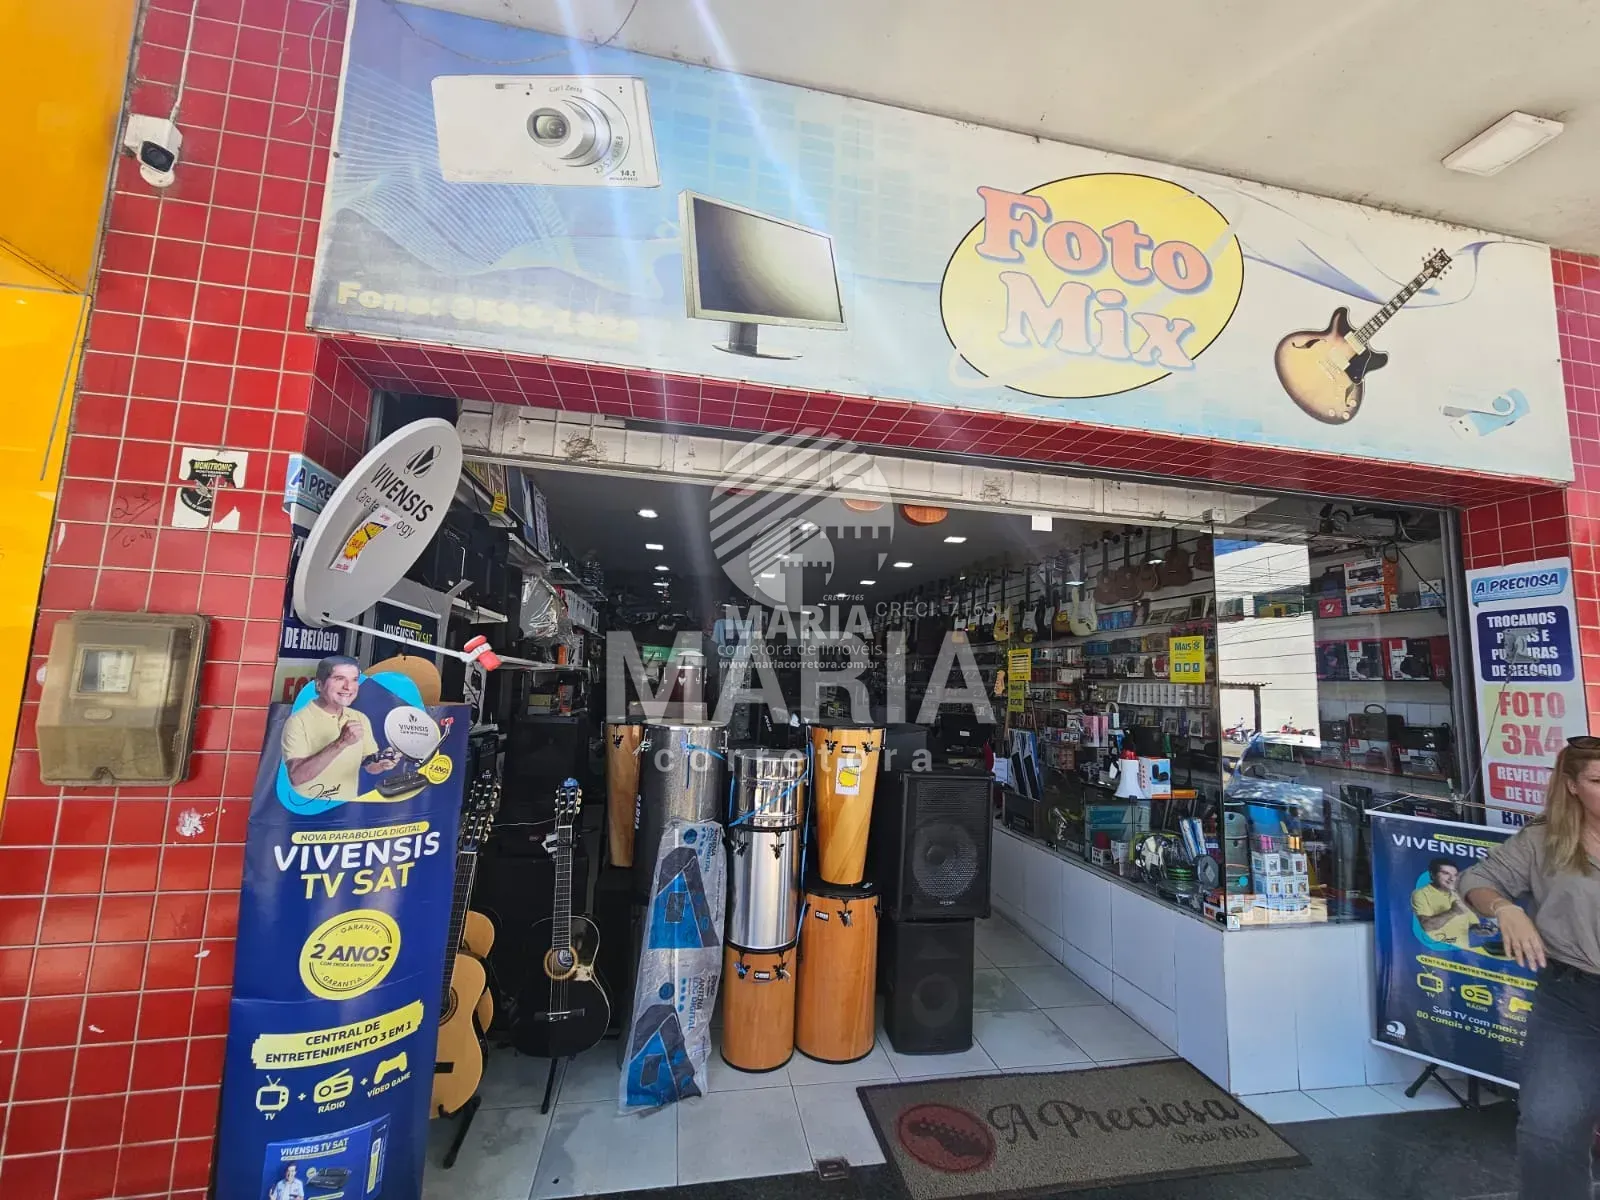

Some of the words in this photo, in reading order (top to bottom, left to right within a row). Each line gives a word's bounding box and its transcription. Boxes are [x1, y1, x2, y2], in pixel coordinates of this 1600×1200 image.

[975, 186, 1213, 294] Foto
[999, 270, 1196, 370] Mix
[290, 466, 306, 489] A
[371, 462, 436, 522] VIVENSIS
[1475, 582, 1486, 594] A
[1489, 573, 1559, 592] PRECIOSA
[1486, 611, 1557, 628] TROCAMOS
[284, 626, 298, 649] DE
[1541, 629, 1551, 642] E
[1491, 664, 1507, 677] DE
[1498, 691, 1566, 719] FOTO
[1501, 723, 1565, 757] 3X4
[1504, 786, 1523, 800] DE
[300, 833, 328, 842] NOVA
[389, 824, 422, 837] DIGITAL
[1392, 833, 1489, 859] VIVENSIS
[274, 831, 441, 872] VIVENSIS
[300, 871, 346, 900] TV
[352, 861, 416, 896] SAT
[340, 924, 381, 935] GARANTIA
[310, 943, 326, 960] 2
[327, 945, 393, 962] ANOS
[322, 975, 362, 988] GARANTIA
[687, 996, 698, 1032] DIGITAL
[1432, 1005, 1452, 1017] Sua
[1453, 1010, 1468, 1020] TV
[1468, 1016, 1491, 1028] com
[1492, 1023, 1518, 1035] mais
[265, 1036, 379, 1063] ENTRETENIMENTO
[380, 1031, 388, 1042] 3
[389, 1025, 405, 1038] EM
[405, 1021, 412, 1031] 1
[305, 1027, 363, 1047] CENTRAL
[364, 1020, 381, 1034] DE
[1430, 1014, 1463, 1029] canais
[1472, 1025, 1487, 1035] 30
[1487, 1029, 1518, 1044] jogos
[264, 1112, 276, 1121] TV
[317, 1100, 346, 1114] RÁDIO
[366, 1083, 391, 1099] VÍDEO
[391, 1071, 412, 1088] GAME
[987, 1103, 1039, 1144] A
[1037, 1097, 1240, 1139] Preciosa
[280, 1143, 320, 1156] VIVENSIS
[320, 1143, 332, 1151] TV
[333, 1137, 350, 1149] SAT
[1172, 1131, 1218, 1145] Desde
